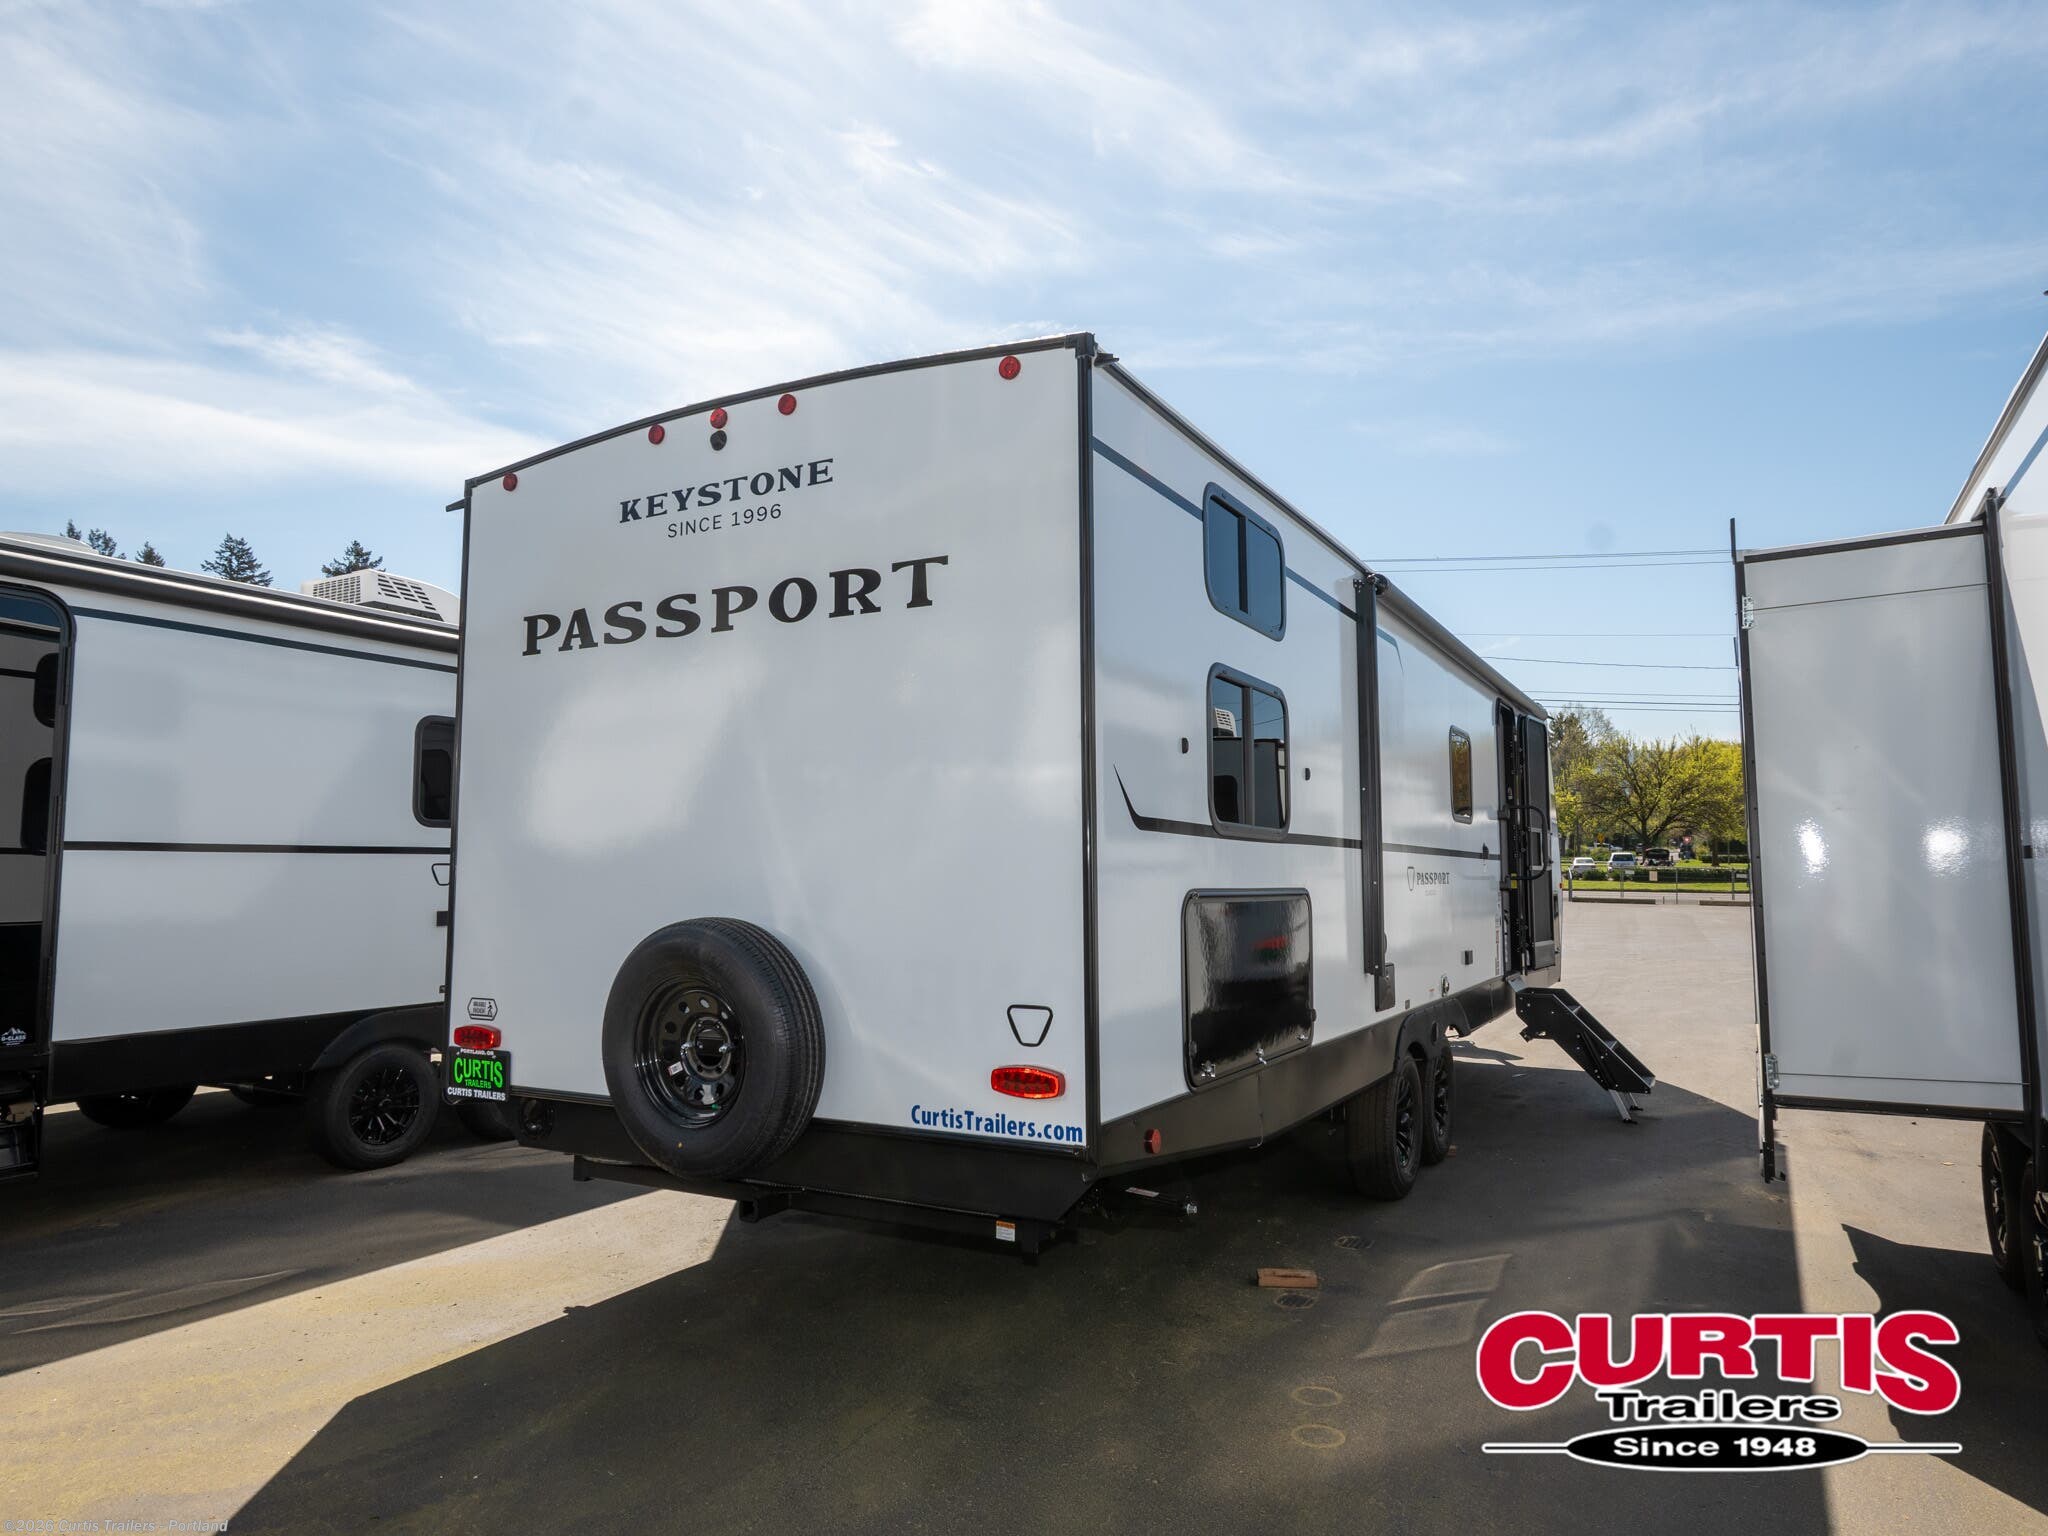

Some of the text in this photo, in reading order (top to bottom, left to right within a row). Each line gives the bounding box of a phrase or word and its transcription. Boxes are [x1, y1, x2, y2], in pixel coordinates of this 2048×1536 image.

[619, 458, 834, 523] KEYSTONE
[667, 503, 782, 538] SINCE 1996
[522, 555, 949, 656] PASSPORT
[1416, 872, 1450, 885] PASSPORT
[454, 1057, 503, 1088] CURTIS
[465, 1079, 491, 1089] TRAILERS
[447, 1086, 506, 1101] CURTIS TRAILERS
[911, 1104, 1083, 1143] CurtisTrailers.com
